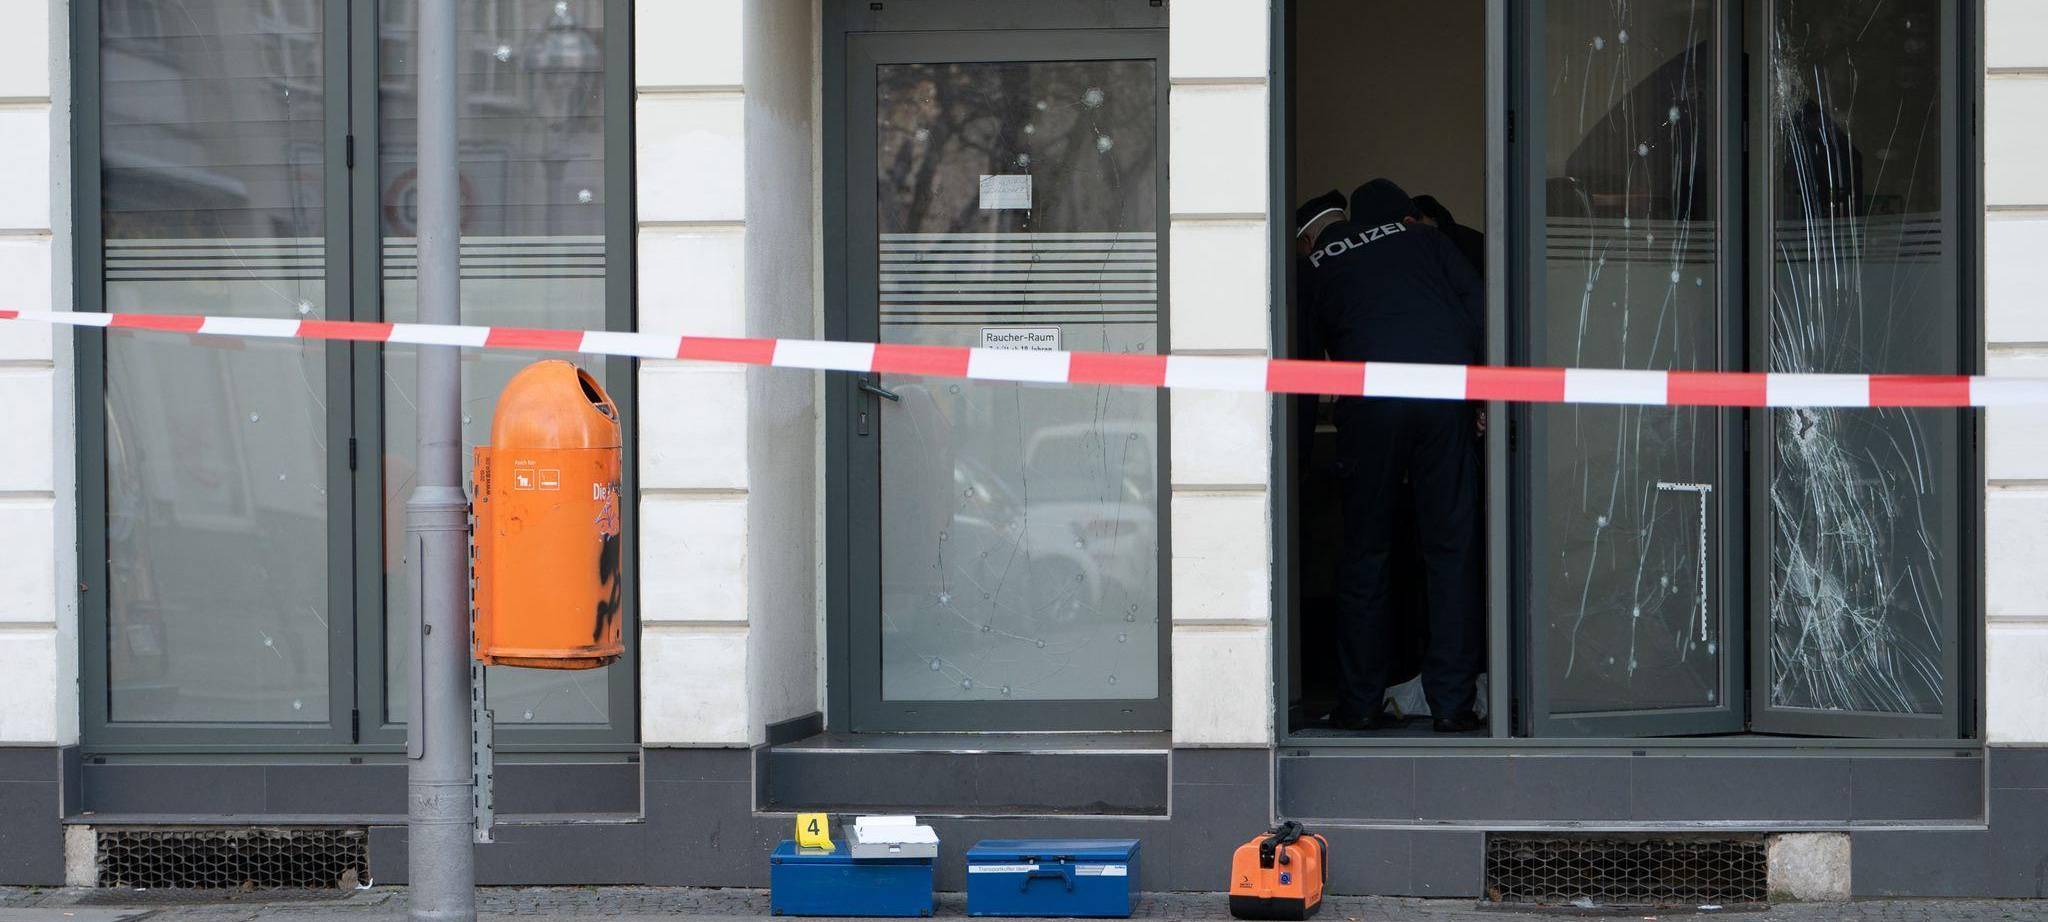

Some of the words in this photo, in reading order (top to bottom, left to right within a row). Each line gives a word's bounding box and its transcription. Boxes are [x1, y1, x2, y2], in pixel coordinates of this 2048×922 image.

[1309, 222, 1407, 268] POLIZEI
[986, 333, 1055, 342] Raucher-Raum
[593, 482, 607, 500] Die
[808, 818, 820, 835] 4
